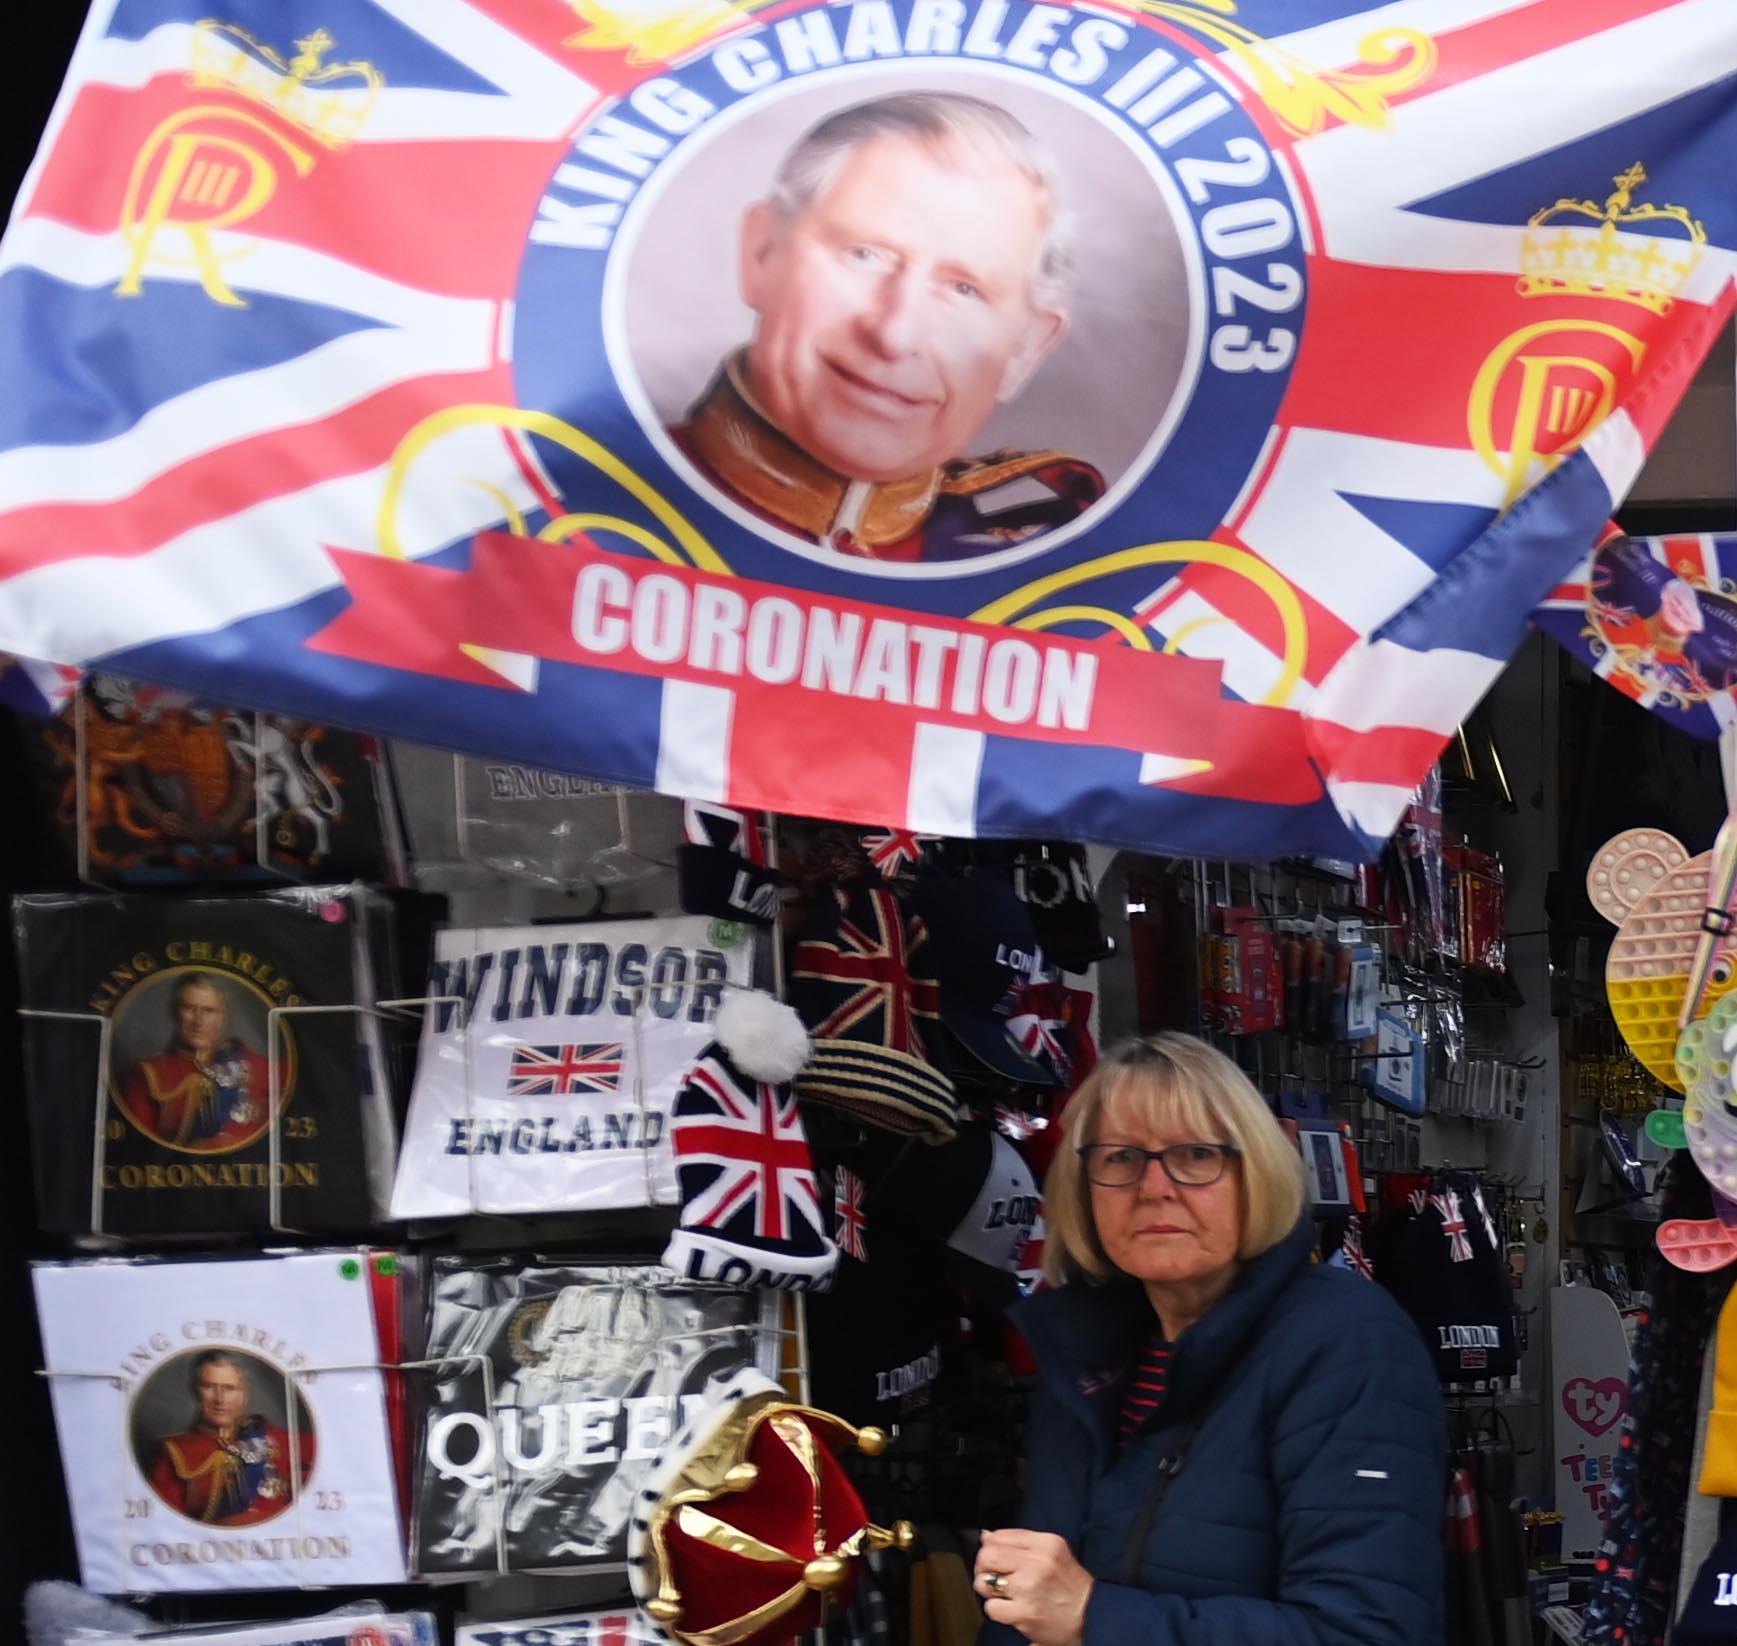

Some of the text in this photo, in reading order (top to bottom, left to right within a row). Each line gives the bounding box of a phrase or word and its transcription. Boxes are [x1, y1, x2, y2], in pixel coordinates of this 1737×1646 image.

[530, 0, 1306, 377] KING CHARLES III 2023
[571, 562, 1100, 732] CORONATION
[430, 942, 731, 1034] WINDSOR
[443, 1110, 664, 1156] ENGLAND
[1438, 1324, 1500, 1350] LONDON
[131, 1536, 349, 1568] CORONATION
